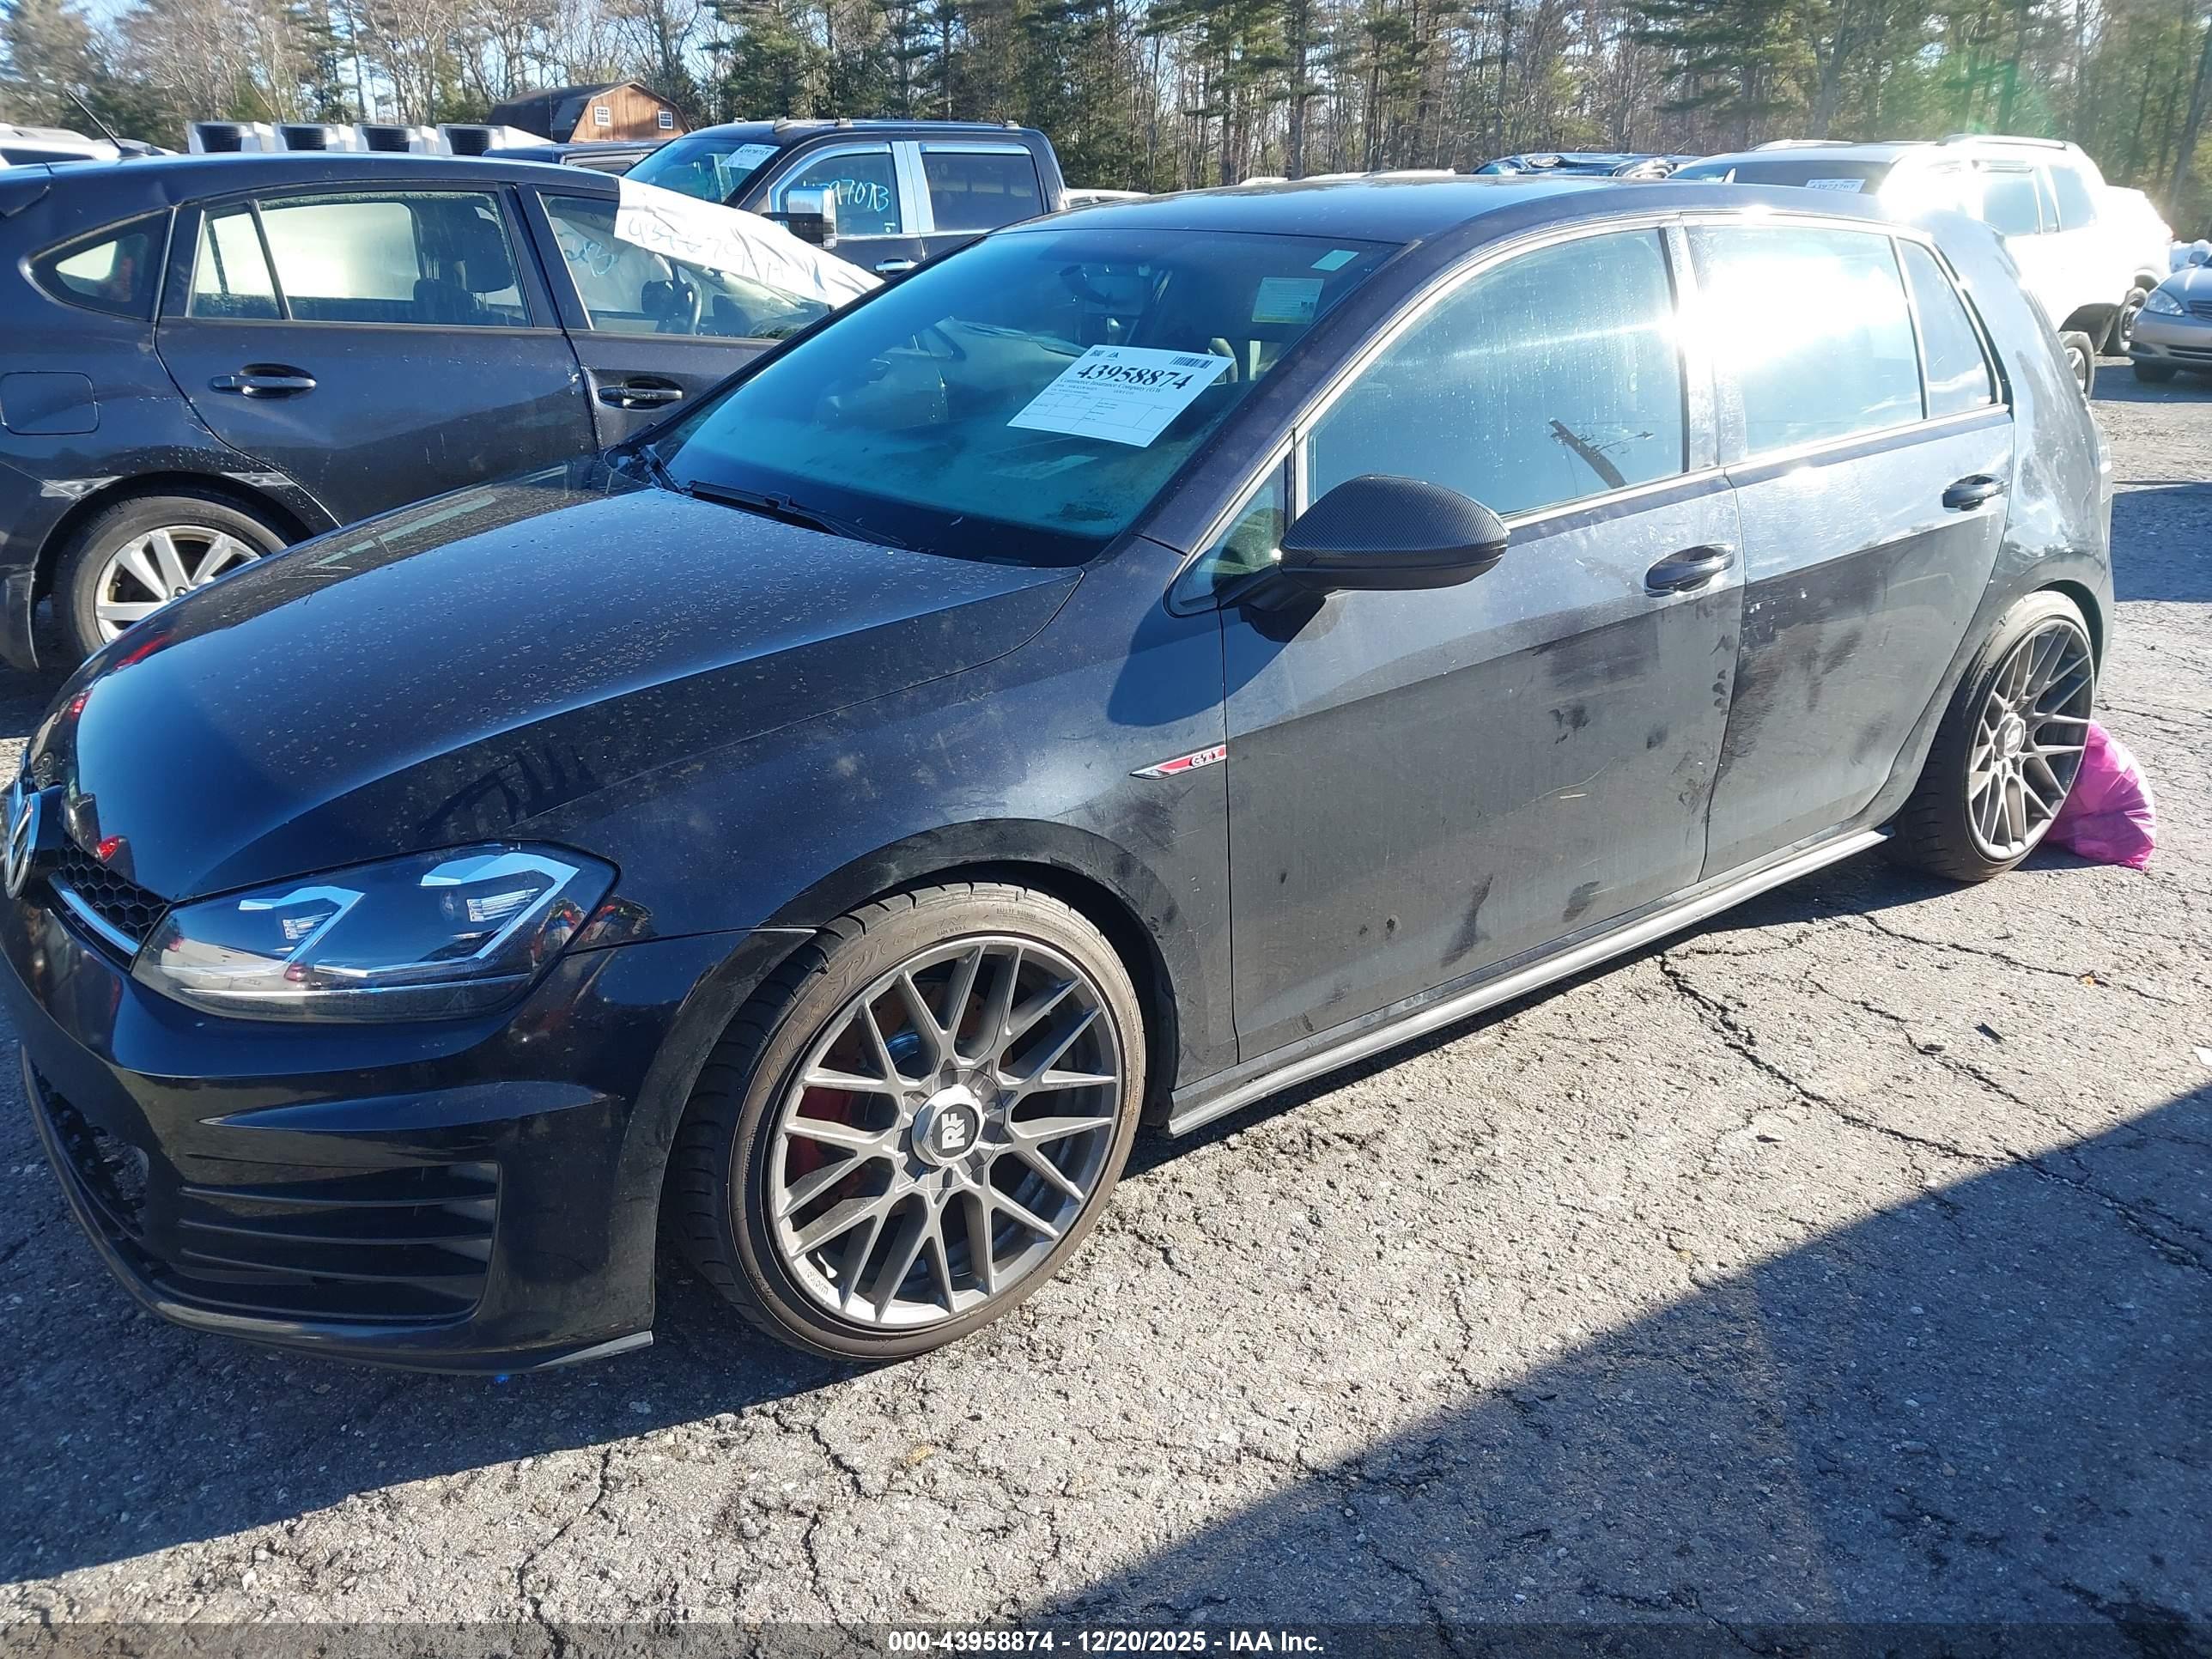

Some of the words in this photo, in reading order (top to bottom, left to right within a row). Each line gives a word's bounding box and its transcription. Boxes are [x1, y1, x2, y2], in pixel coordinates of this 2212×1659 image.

[802, 178, 890, 212] 970713
[1077, 363, 1194, 390] 43958874
[1191, 750, 1221, 768] GTI
[941, 1112, 965, 1150] RF
